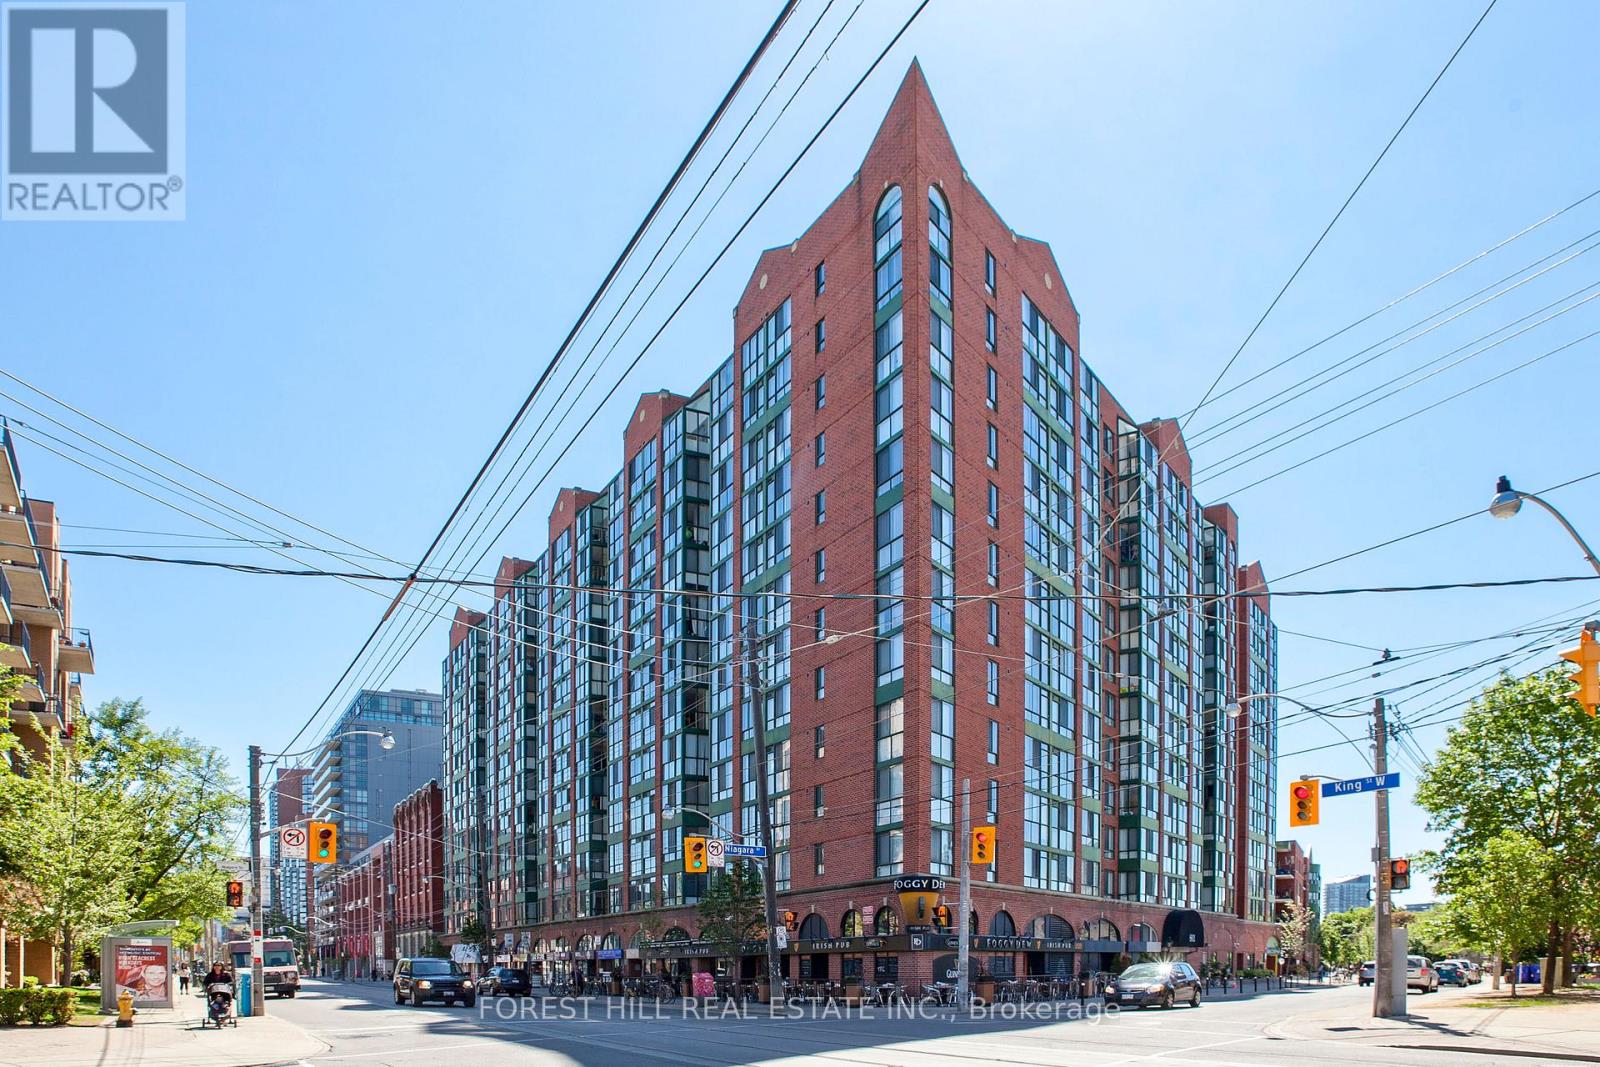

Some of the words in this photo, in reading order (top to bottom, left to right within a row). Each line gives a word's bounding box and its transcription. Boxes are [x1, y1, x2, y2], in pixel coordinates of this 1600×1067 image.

[1334, 781, 1362, 793] King
[1375, 775, 1386, 787] W
[724, 845, 754, 856] Niagara
[893, 879, 928, 890] FOGGY
[812, 942, 833, 950] IRISH
[835, 941, 850, 949] PUB
[986, 938, 1013, 949] FOGGY
[1015, 939, 1032, 949] DEW
[946, 968, 960, 978] GUIN
